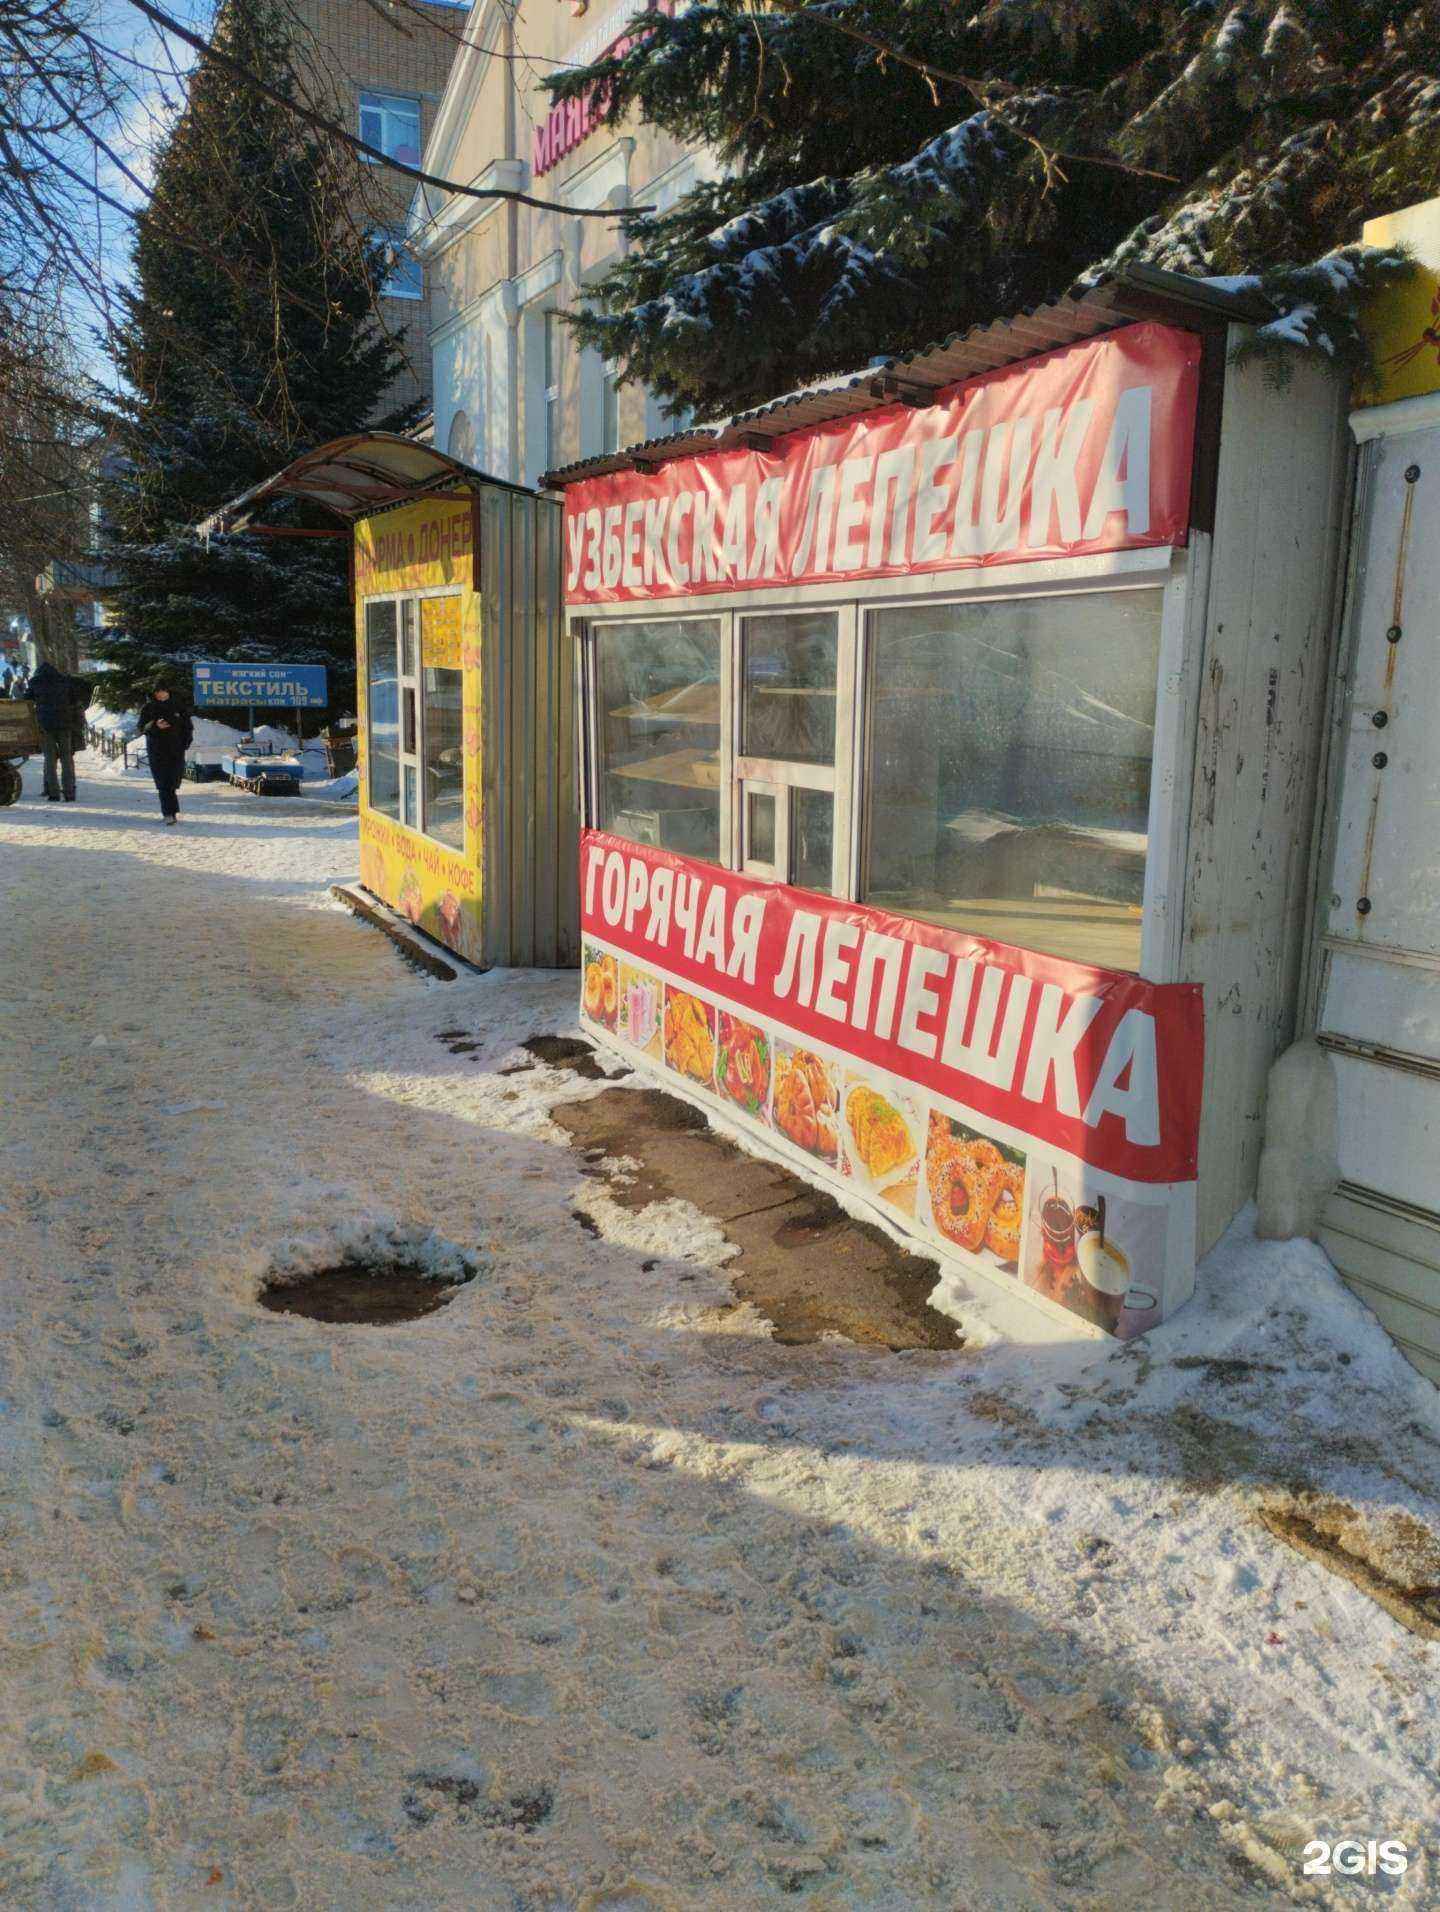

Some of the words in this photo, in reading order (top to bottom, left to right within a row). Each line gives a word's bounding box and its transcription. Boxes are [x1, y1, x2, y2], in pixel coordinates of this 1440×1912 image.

[567, 476, 785, 591] УЗБЕКСКАЯ
[792, 385, 1153, 577] ЛЕПЕШКА
[417, 512, 473, 565] ДОНЕР
[198, 680, 309, 696] ТЕКСТИЛЬ
[422, 847, 440, 880] ЧАЙ
[448, 861, 475, 895] КОФЕ
[585, 845, 768, 986] ГОРЯЧАЯ
[773, 910, 1162, 1147] ЛЕПЕШКА
